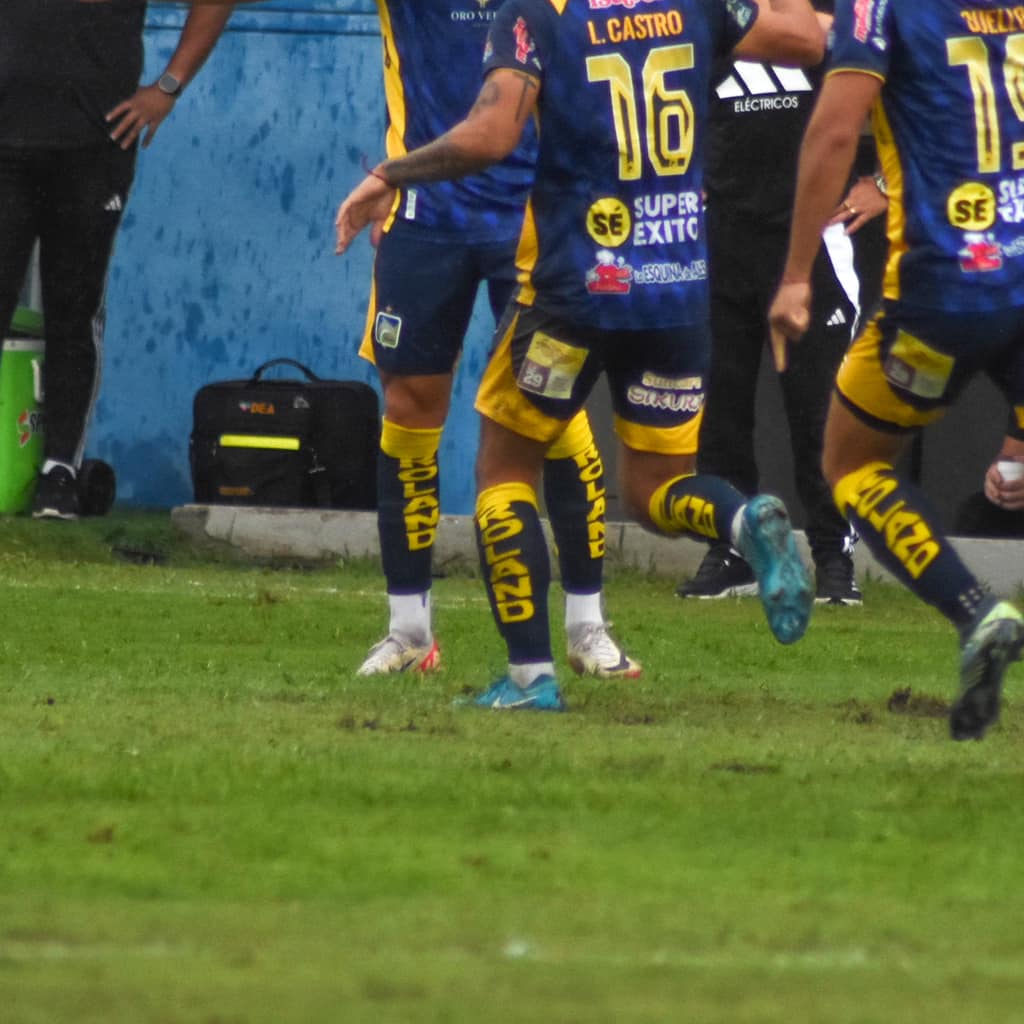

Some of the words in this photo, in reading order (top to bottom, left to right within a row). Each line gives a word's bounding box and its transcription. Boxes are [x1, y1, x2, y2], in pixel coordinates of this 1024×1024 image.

[450, 10, 476, 21] ORO
[587, 21, 606, 45] L.
[607, 9, 683, 43] CASTRO
[585, 43, 695, 180] 16
[734, 96, 799, 113] ELÉCTRICOS
[634, 192, 698, 218] SUPER
